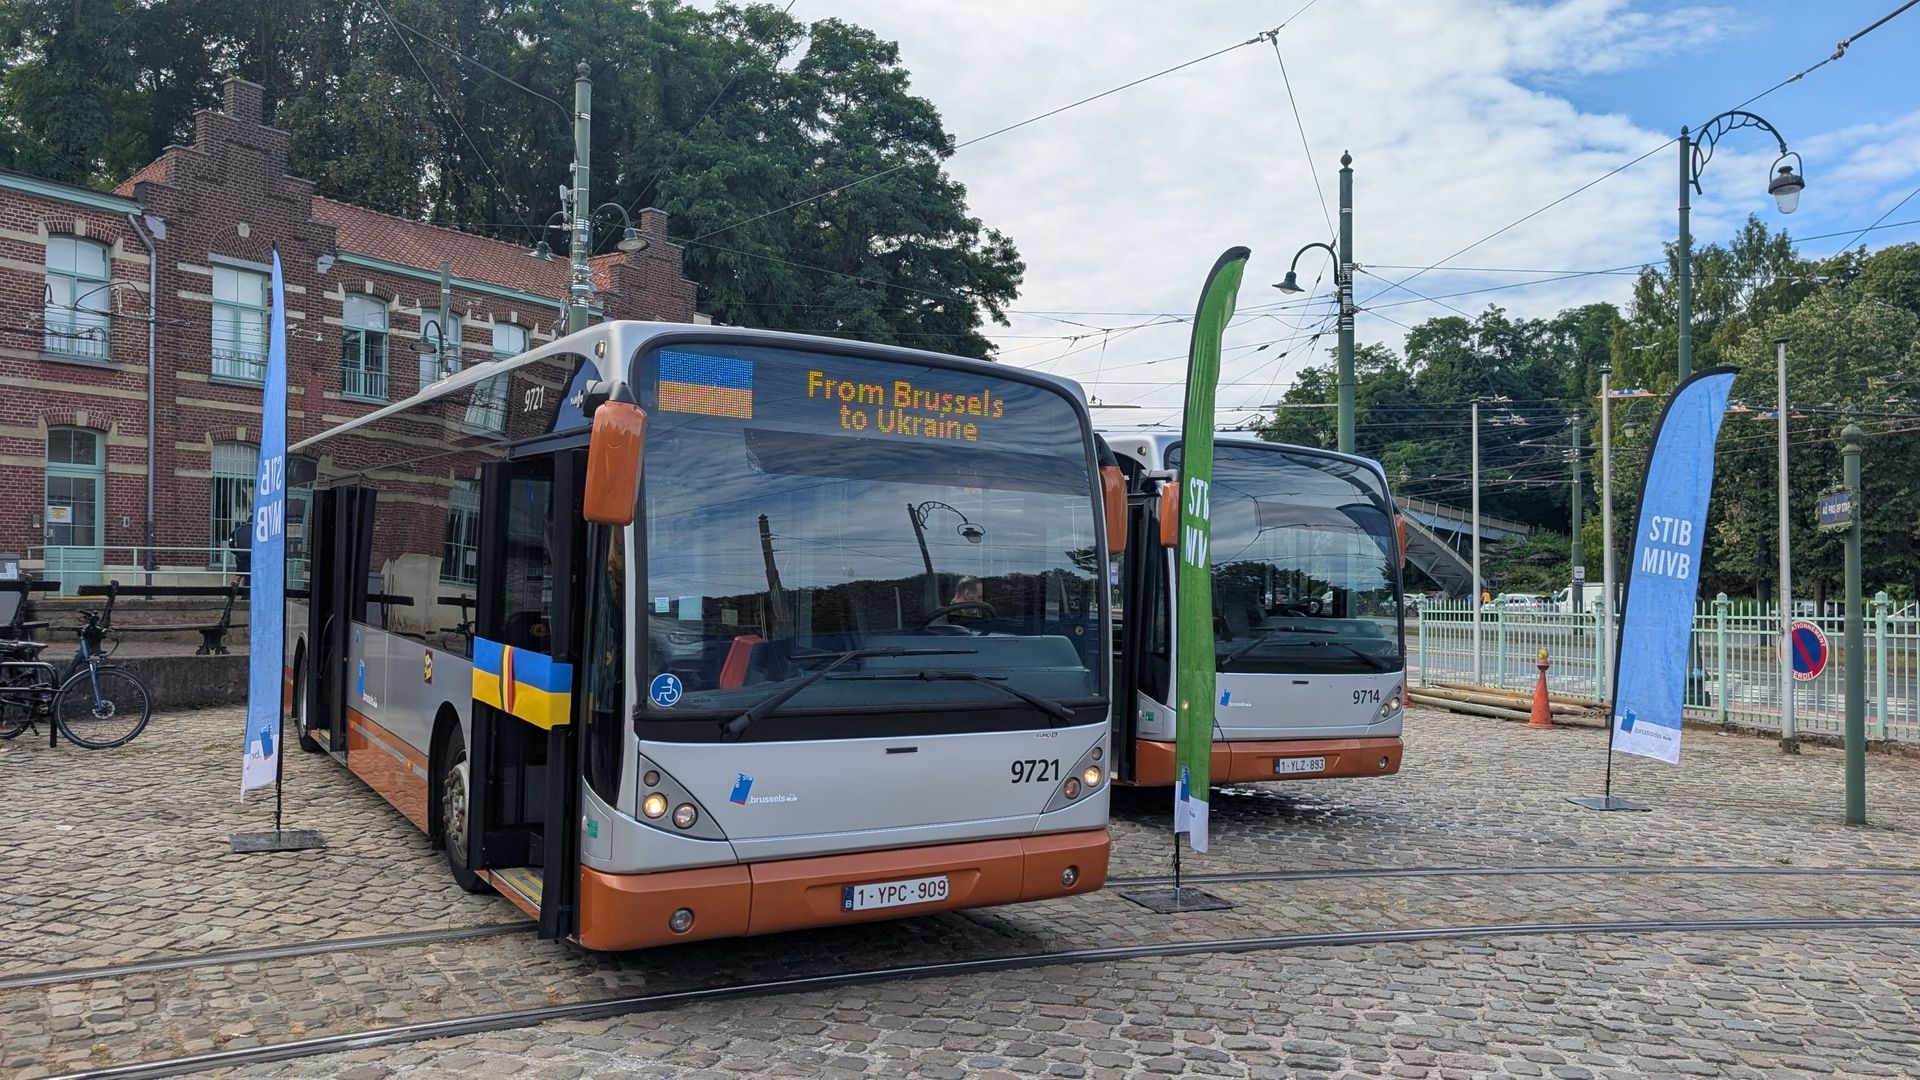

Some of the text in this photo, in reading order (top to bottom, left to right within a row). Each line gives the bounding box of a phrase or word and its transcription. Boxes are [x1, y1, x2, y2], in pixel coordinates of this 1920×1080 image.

[524, 386, 545, 412] 9721
[808, 370, 1004, 418] From Brussels
[840, 404, 977, 441] to Ukraine
[1650, 515, 1692, 546] STIB
[1642, 547, 1690, 580] MIVB
[1353, 689, 1380, 704] 9714
[1011, 759, 1059, 784] 9721
[1281, 759, 1324, 771] 1-YLZ-893
[845, 900, 852, 908] B
